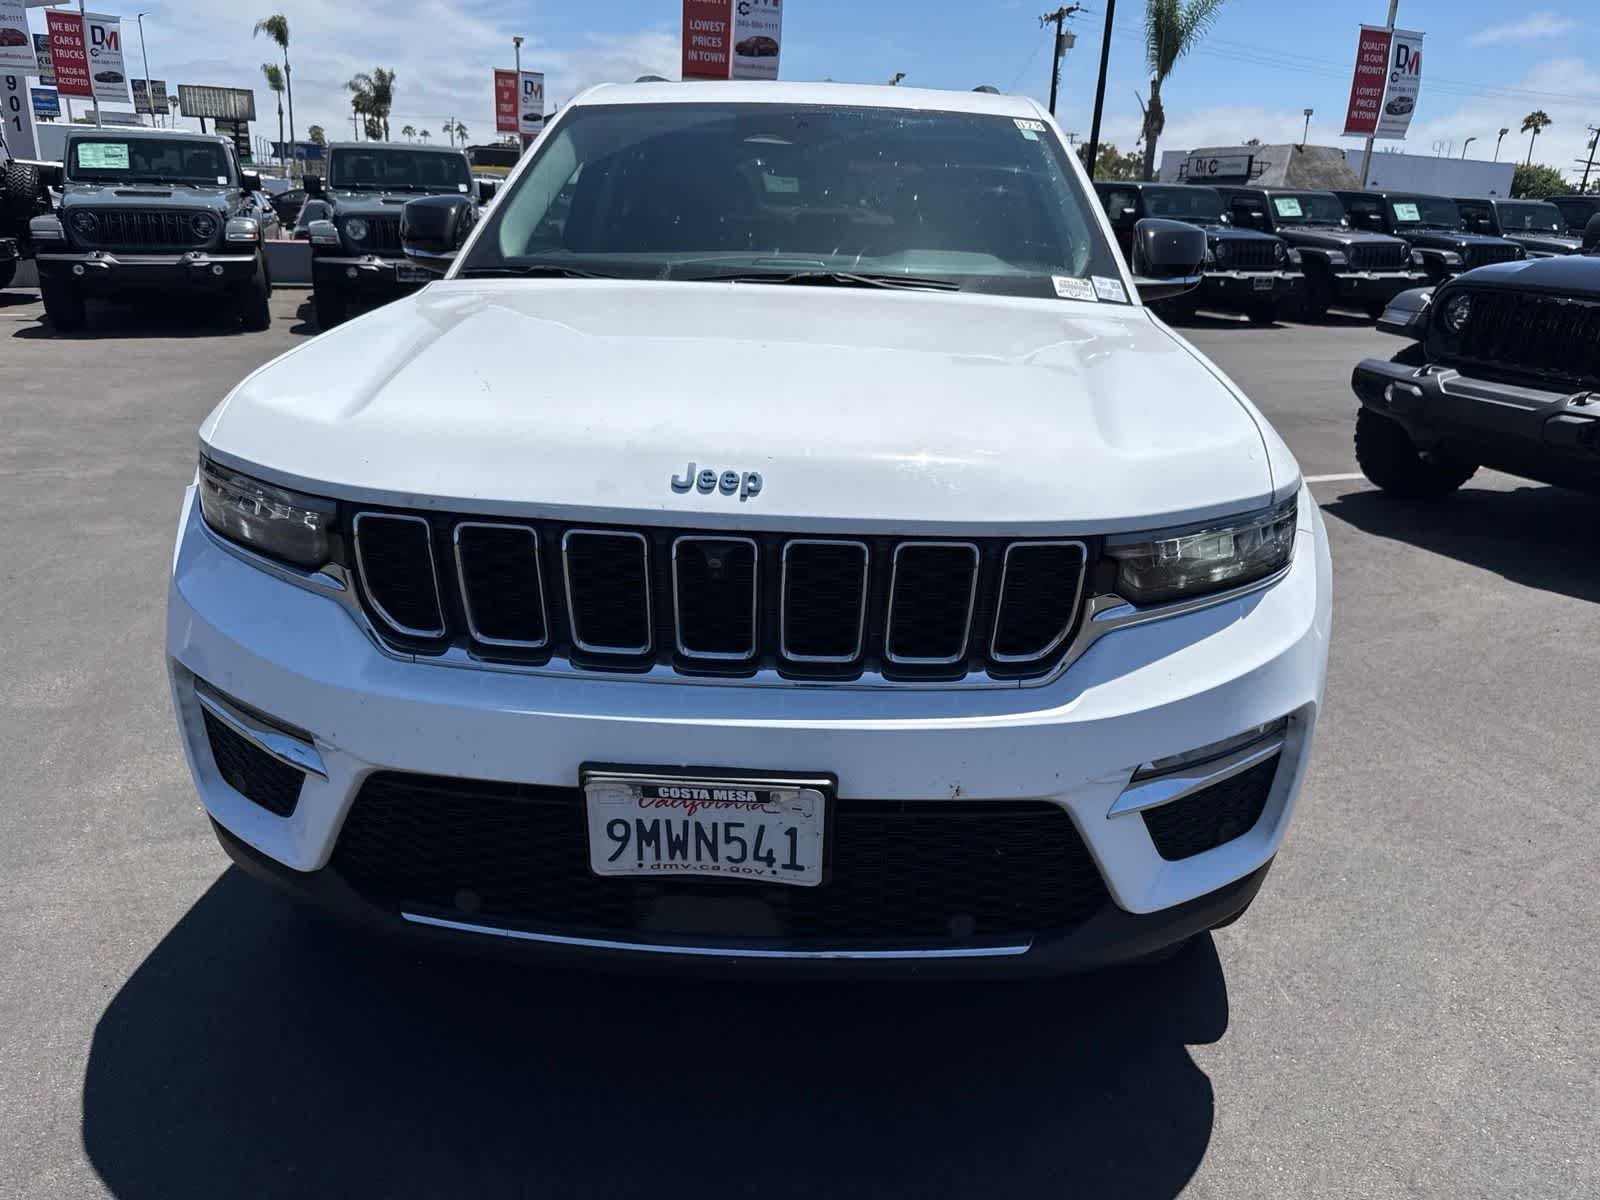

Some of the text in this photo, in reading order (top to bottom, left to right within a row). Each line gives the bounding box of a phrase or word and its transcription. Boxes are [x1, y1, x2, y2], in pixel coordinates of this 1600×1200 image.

[51, 22, 80, 33] WE BUY
[689, 20, 726, 33] LOWEST
[54, 35, 81, 46] CARS &
[692, 35, 722, 48] PRICES
[1362, 41, 1387, 53] QUALITY
[55, 48, 85, 60] TRUCKS
[688, 50, 725, 63] IN TOWN
[1369, 54, 1384, 64] OUR
[58, 67, 74, 75] TRADE
[1358, 65, 1385, 76] PRIORITY
[59, 77, 89, 87] ACCEPTED
[1356, 87, 1381, 97] LOWEST
[1356, 99, 1377, 109] PRICES
[1358, 111, 1377, 120] TOWN
[671, 462, 763, 502] Jeep
[658, 786, 758, 803] COSTA MESA
[605, 818, 806, 872] 9MWN541
[650, 862, 764, 875] dmv.ca.gov
